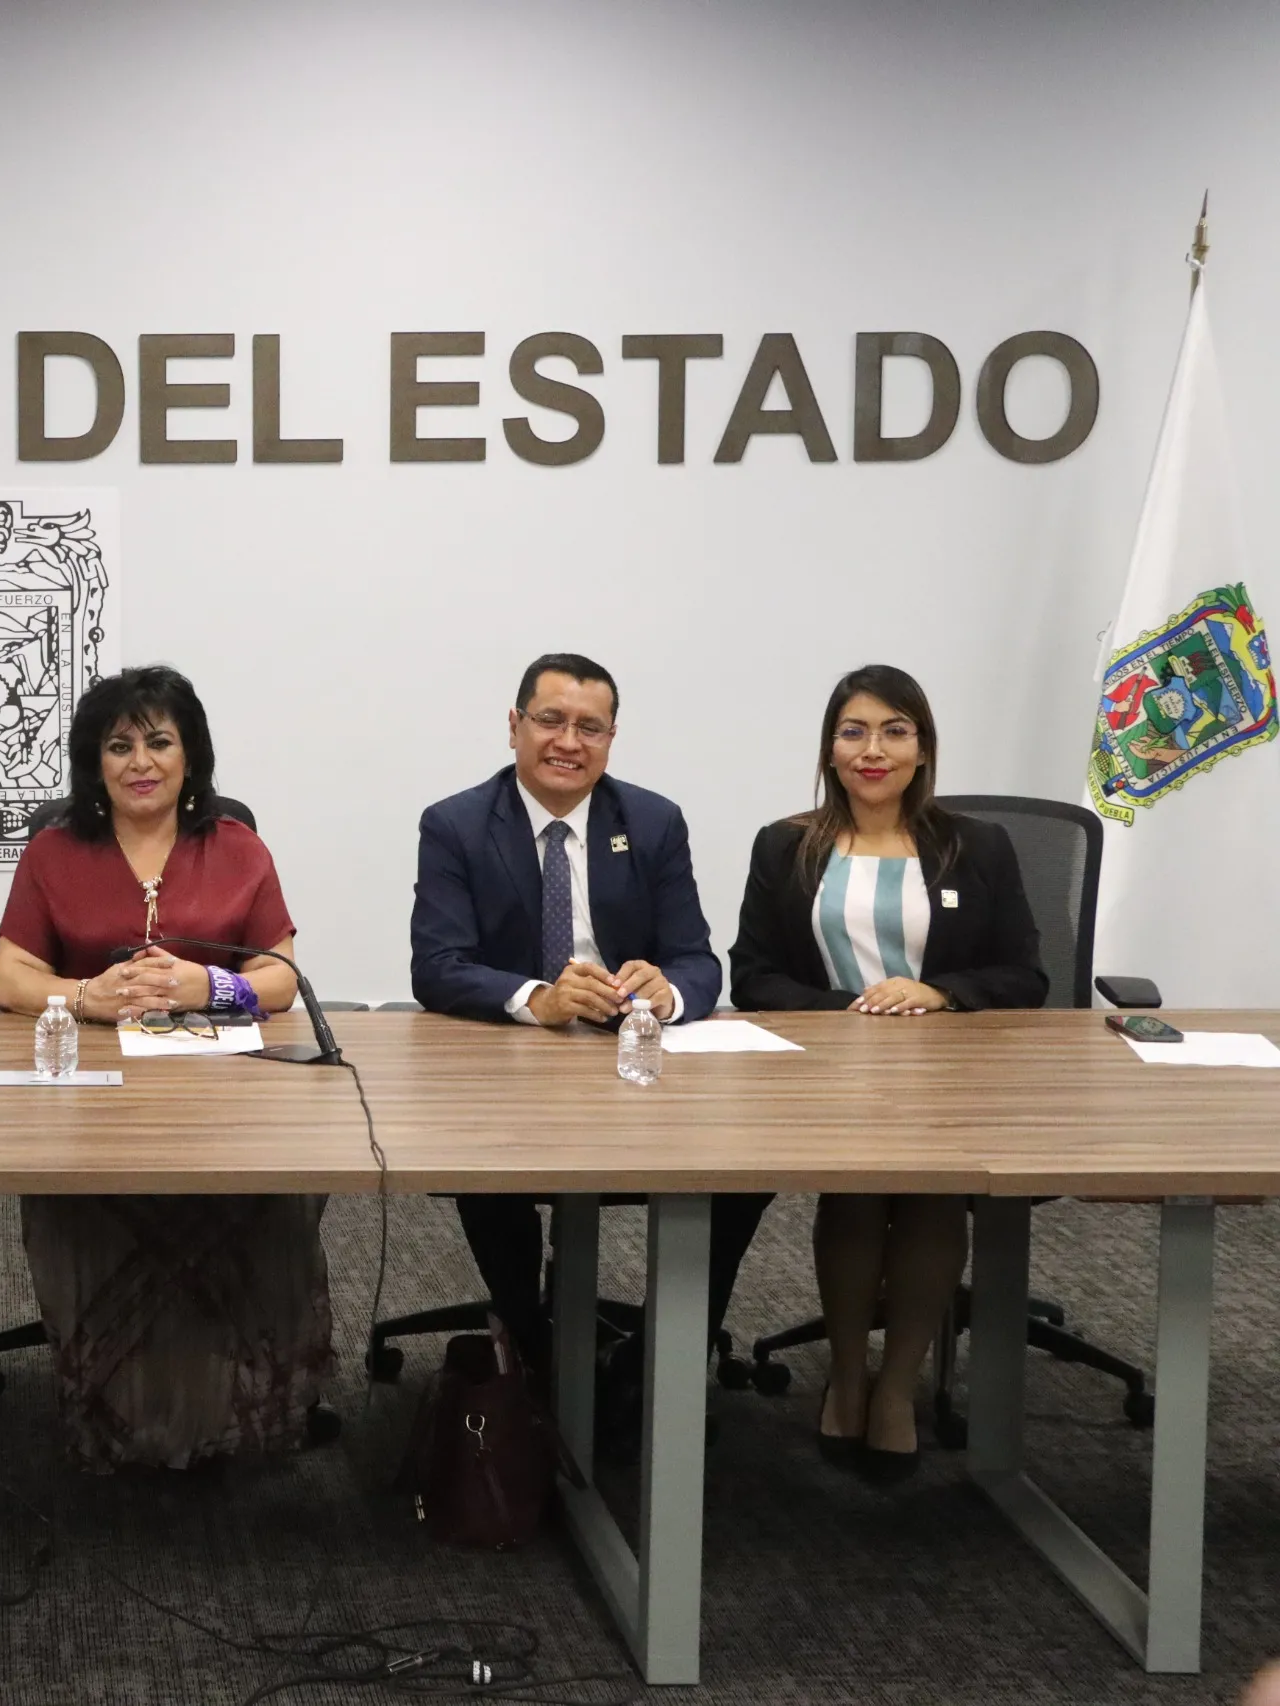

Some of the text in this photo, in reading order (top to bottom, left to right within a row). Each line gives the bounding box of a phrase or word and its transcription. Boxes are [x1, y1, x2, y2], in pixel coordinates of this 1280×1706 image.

[17, 332, 344, 465] DEL
[389, 331, 1100, 467] ESTADO
[61, 612, 71, 633] EN
[1130, 656, 1145, 669] EN
[1146, 649, 1158, 660] EL
[1160, 628, 1194, 652] TIEMPO
[61, 649, 71, 667] LA
[1216, 661, 1248, 714] ESFUERZO
[1220, 725, 1239, 740] EN
[1146, 746, 1200, 784] JUSTICIA
[17, 790, 36, 800] LA
[44, 789, 64, 799] EN
[1098, 803, 1130, 818] PUEBLA
[214, 990, 235, 1001] DE
